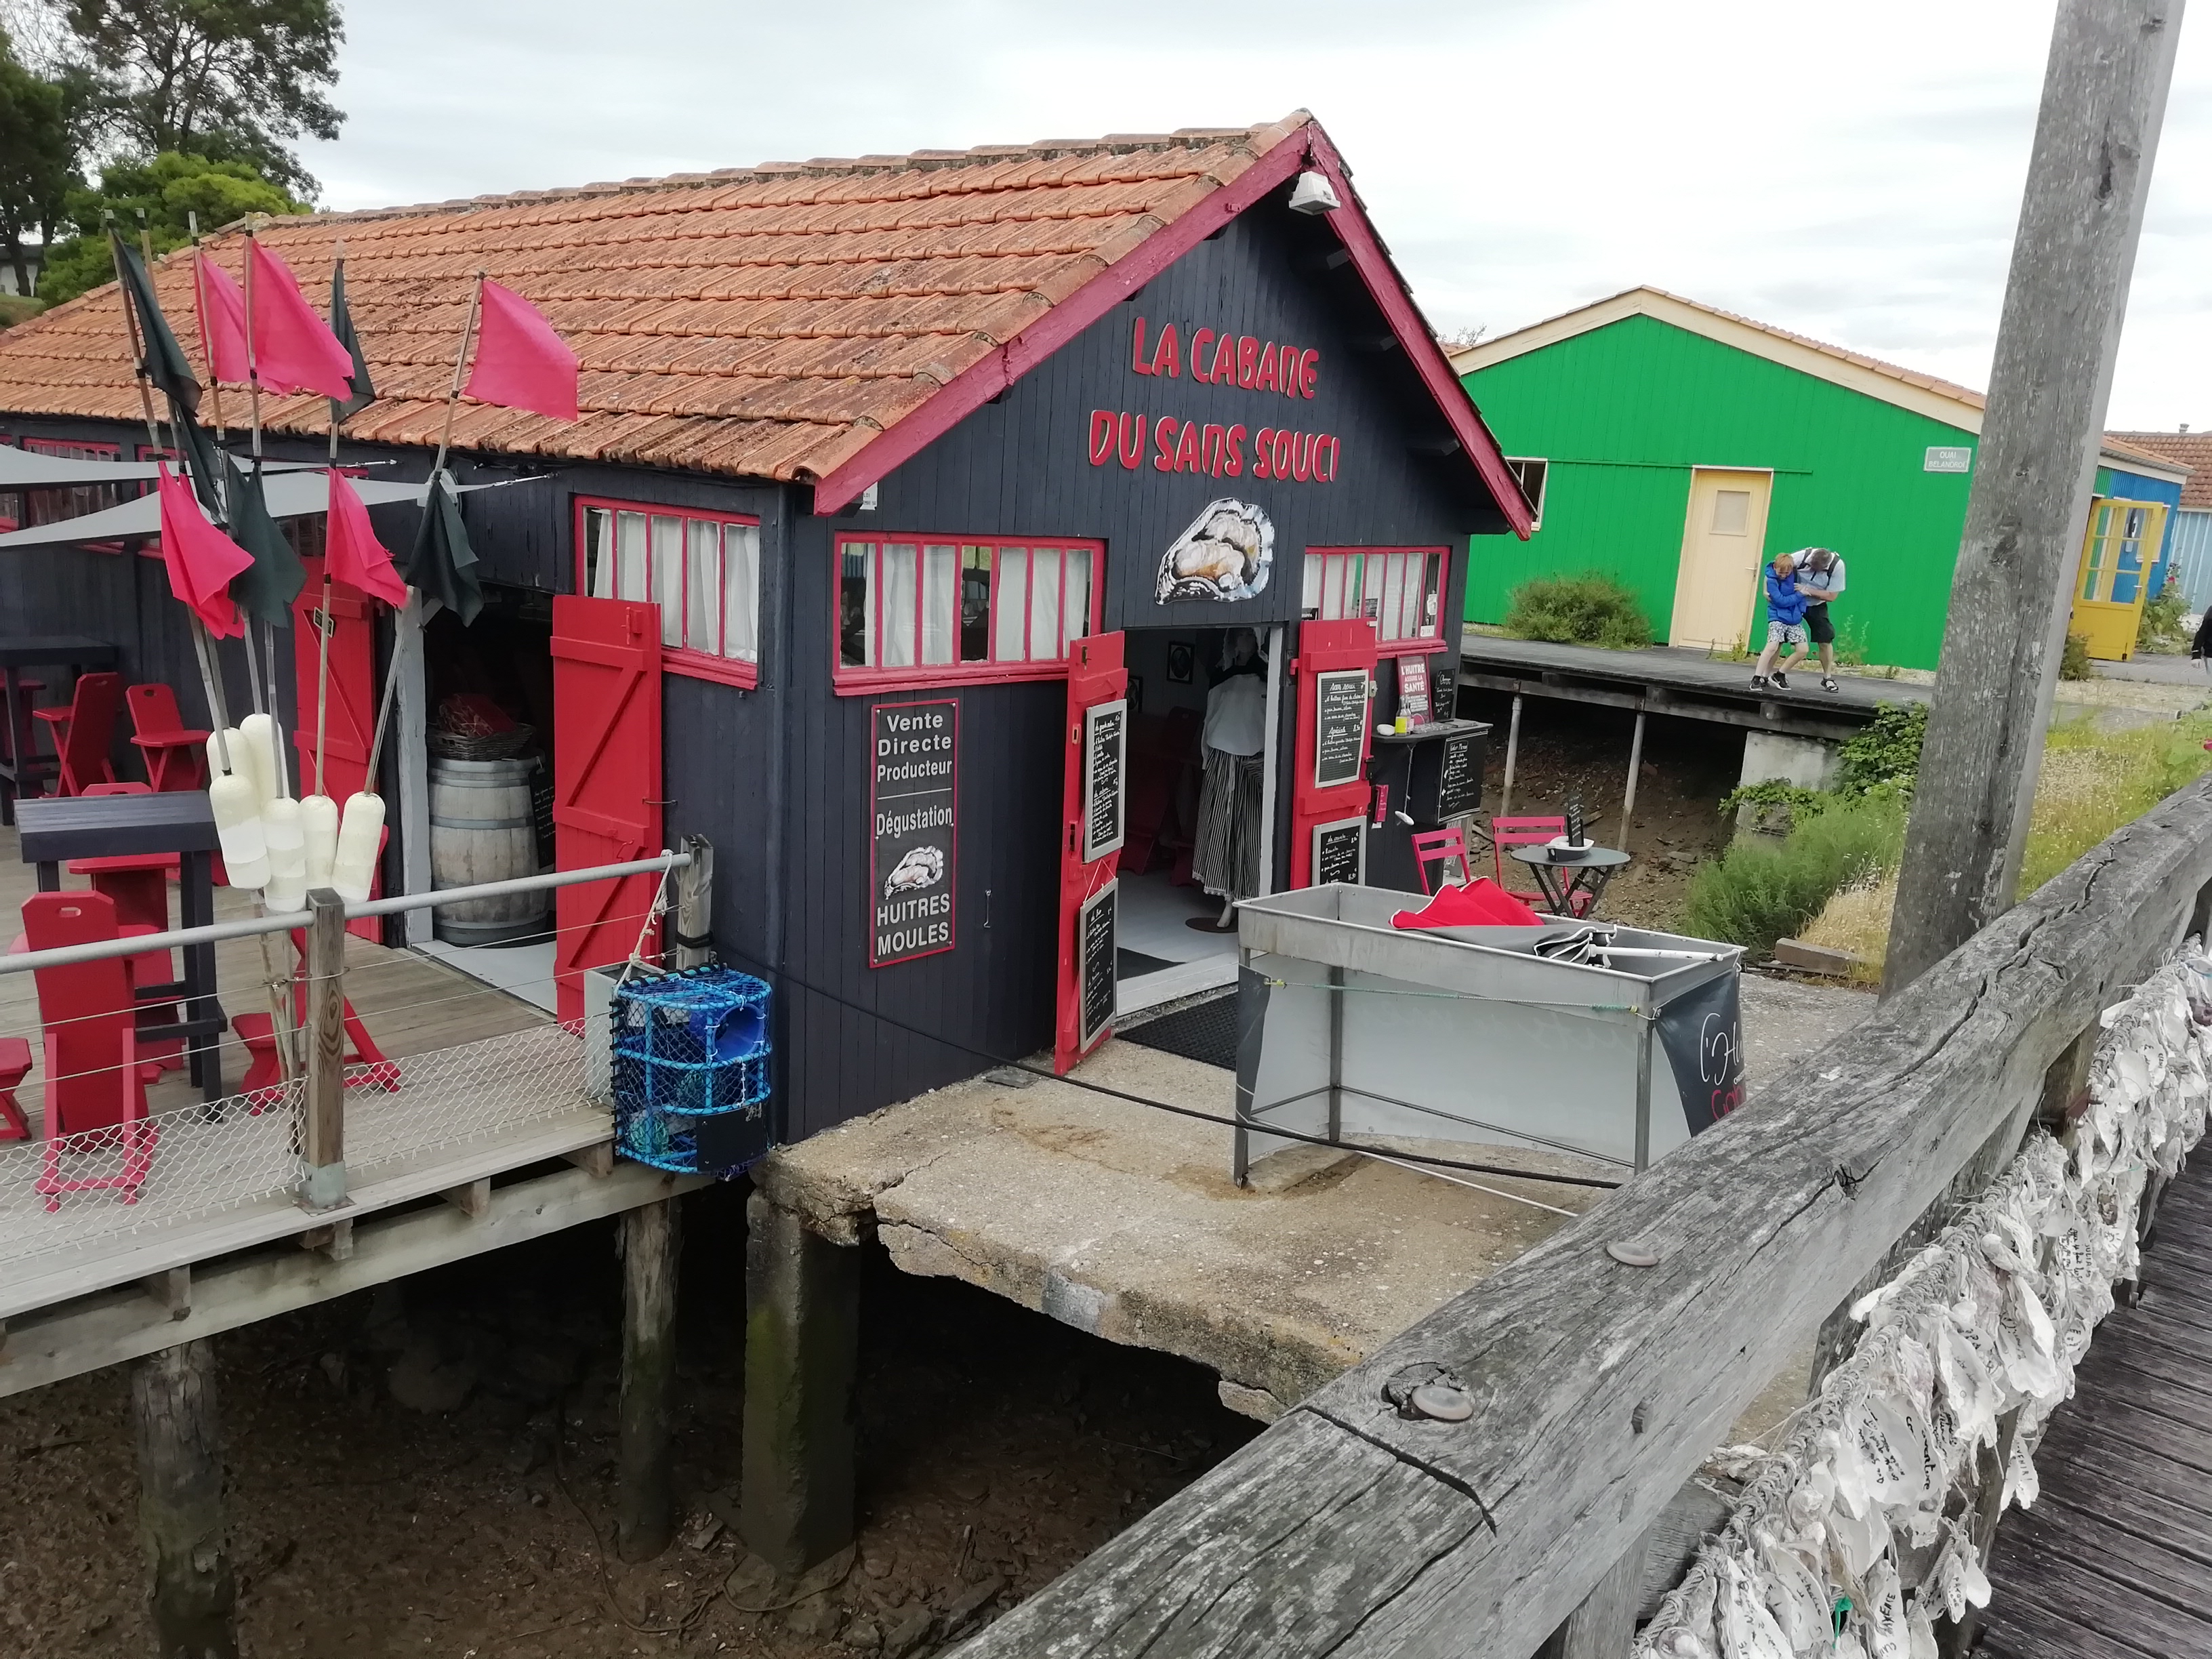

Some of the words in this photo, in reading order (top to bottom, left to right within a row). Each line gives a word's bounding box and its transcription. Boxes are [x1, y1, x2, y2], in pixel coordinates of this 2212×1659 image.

[1132, 316, 1181, 378] LA
[1088, 409, 1147, 469] DU
[1252, 428, 1341, 483] SOUCI
[1404, 680, 1425, 693] SANTÉ
[886, 712, 943, 733] Vente
[878, 735, 952, 756] Directe
[877, 759, 952, 783] Producteur
[876, 804, 952, 839] Dégustation
[877, 893, 950, 926] HUITRES
[877, 921, 949, 956] MOULES
